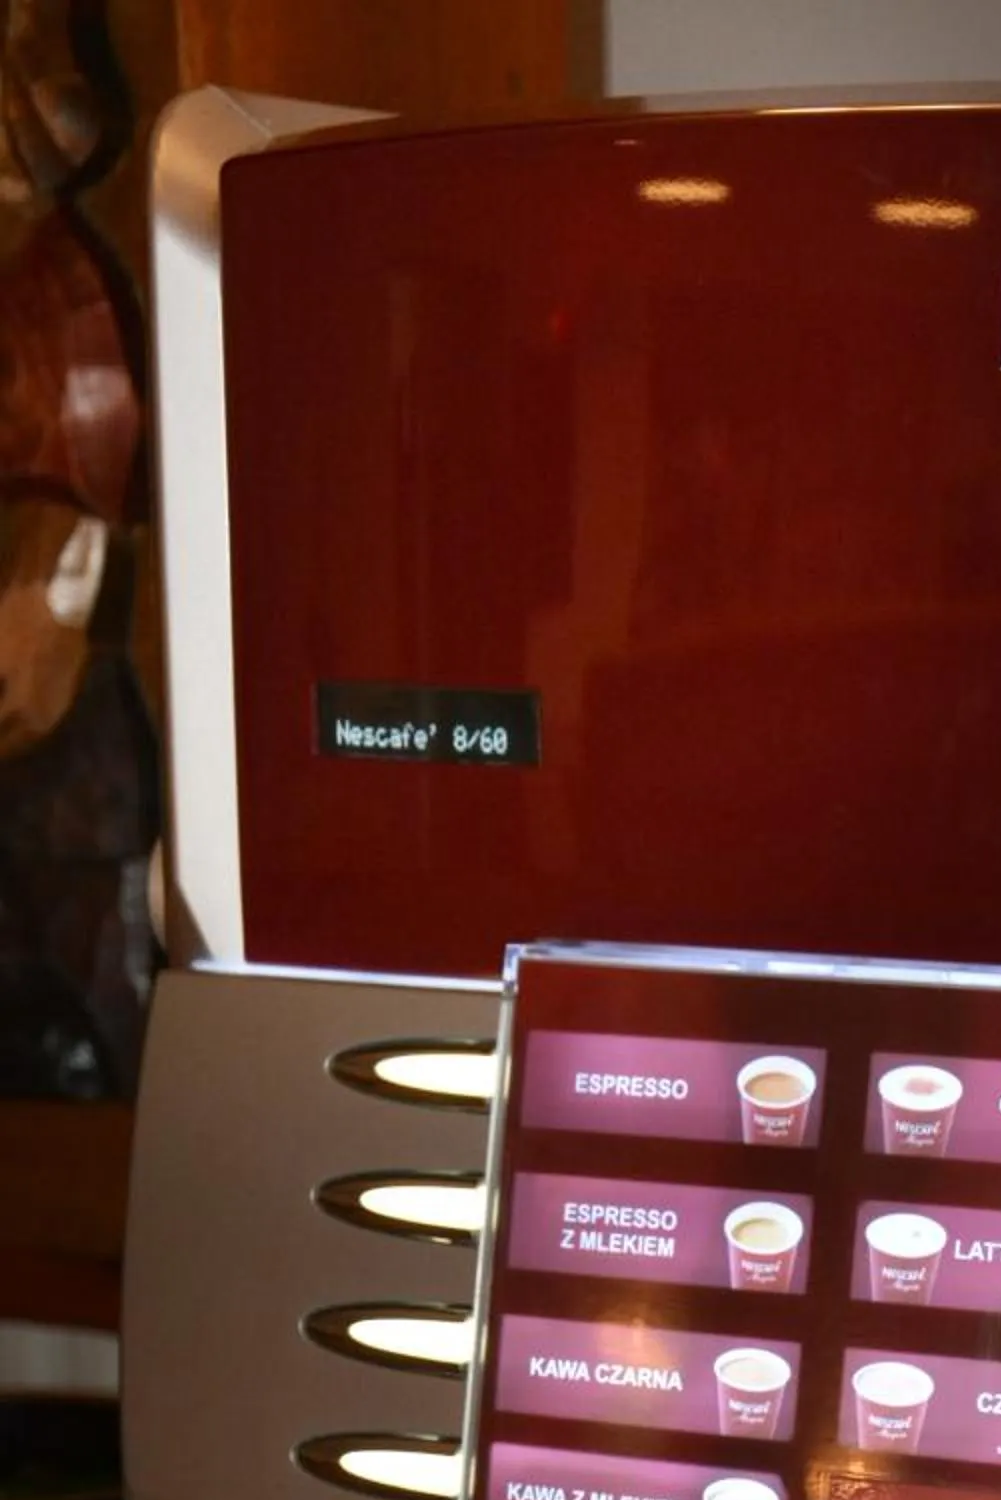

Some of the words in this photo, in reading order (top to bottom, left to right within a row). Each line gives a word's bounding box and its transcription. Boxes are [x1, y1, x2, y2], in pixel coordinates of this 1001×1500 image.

[453, 724, 509, 756] 8/60
[574, 1072, 689, 1100] ESPRESSO
[563, 1202, 678, 1231] ESPRESSO
[560, 1229, 575, 1249] Z
[579, 1230, 675, 1257] MLEKIEM
[529, 1357, 590, 1382] KAWA
[595, 1363, 684, 1392] CZARNA
